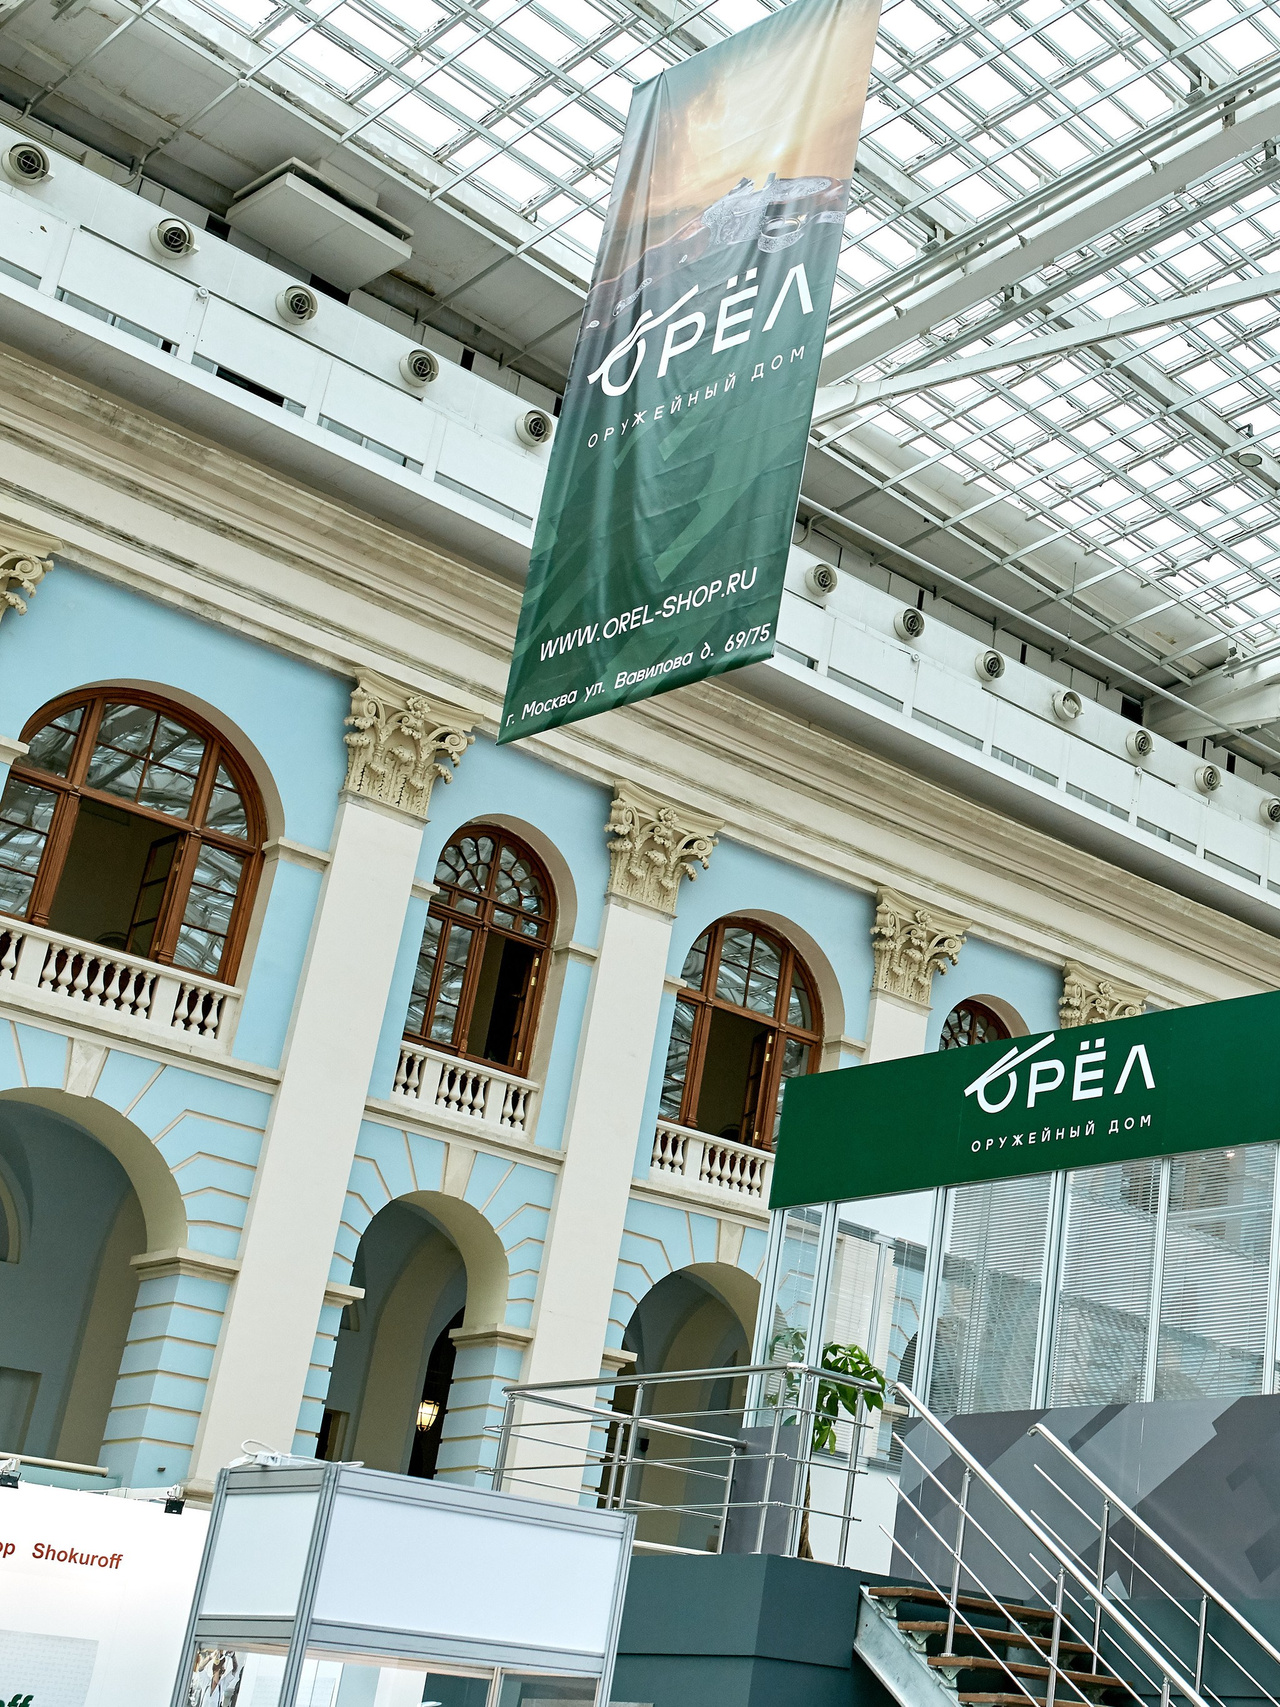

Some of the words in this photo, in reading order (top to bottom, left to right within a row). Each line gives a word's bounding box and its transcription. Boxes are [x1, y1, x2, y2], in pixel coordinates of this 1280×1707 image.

[587, 262, 814, 397] ОРЁЛ
[587, 372, 736, 448] ОРУЖЕЙНЫЙ
[751, 345, 805, 382] ДОМ
[539, 566, 758, 662] WWW.OREL-SHOP.RU
[505, 713, 515, 727] г.
[521, 689, 578, 720] Москва
[584, 681, 605, 703] ул.
[614, 651, 693, 690] Вавилова
[700, 641, 715, 660] д.
[724, 623, 771, 653] 69/75
[963, 1033, 1156, 1114] ОРЁЛ
[971, 1120, 1095, 1152] ОРУЖЕЙНЫЙ
[1108, 1114, 1152, 1135] ДОМ
[32, 1542, 124, 1570] Shokuroff
